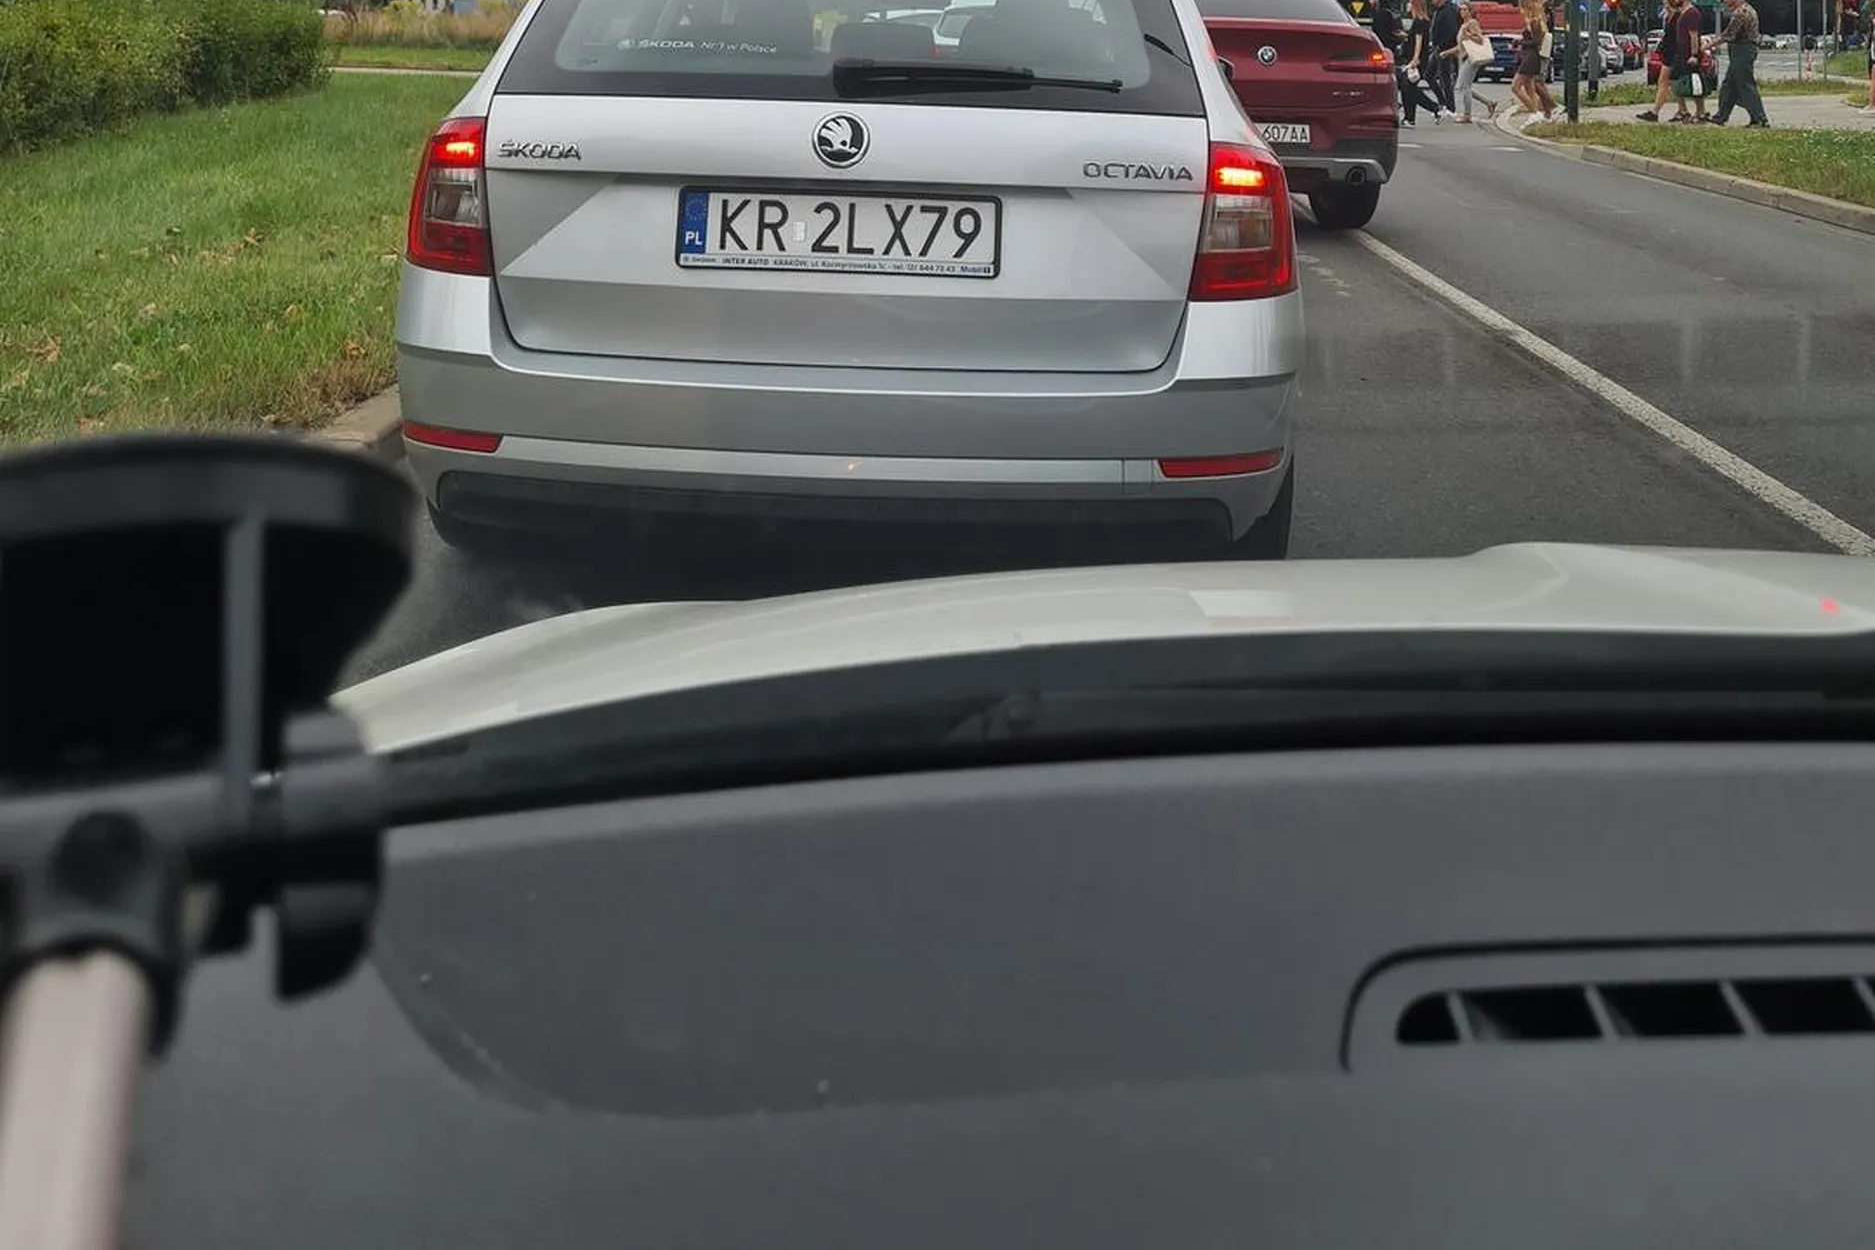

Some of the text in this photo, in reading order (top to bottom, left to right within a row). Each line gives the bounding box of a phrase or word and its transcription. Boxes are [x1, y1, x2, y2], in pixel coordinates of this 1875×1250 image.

[1262, 125, 1309, 143] 607AA
[1083, 162, 1193, 181] OCTAVIA
[719, 199, 981, 258] KR 2LX79
[685, 231, 703, 245] PL
